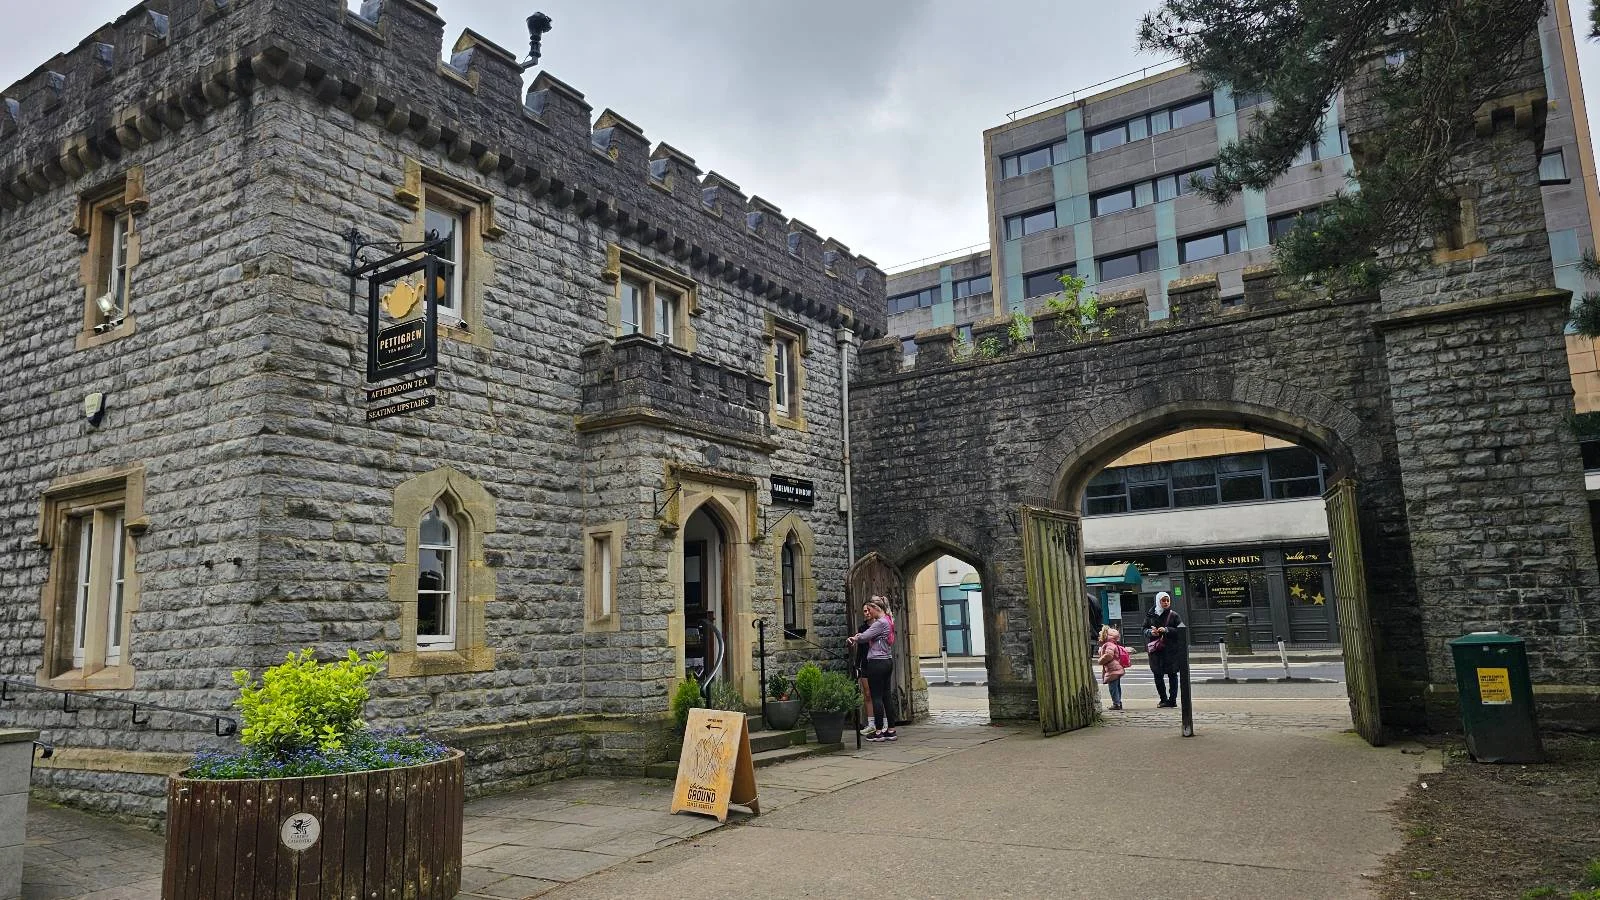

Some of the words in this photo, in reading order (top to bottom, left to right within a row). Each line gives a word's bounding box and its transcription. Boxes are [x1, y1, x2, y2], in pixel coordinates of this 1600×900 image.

[380, 329, 422, 350] PETTIGREW
[371, 381, 413, 399] AFTERNOON
[414, 378, 428, 388] TEA
[368, 405, 396, 419] SEATING
[397, 398, 429, 412] UPSTAIRS
[1188, 558, 1216, 566] WINES
[1219, 557, 1225, 565] &
[1227, 555, 1260, 564] SPIRITS
[687, 789, 716, 803] GROUND
